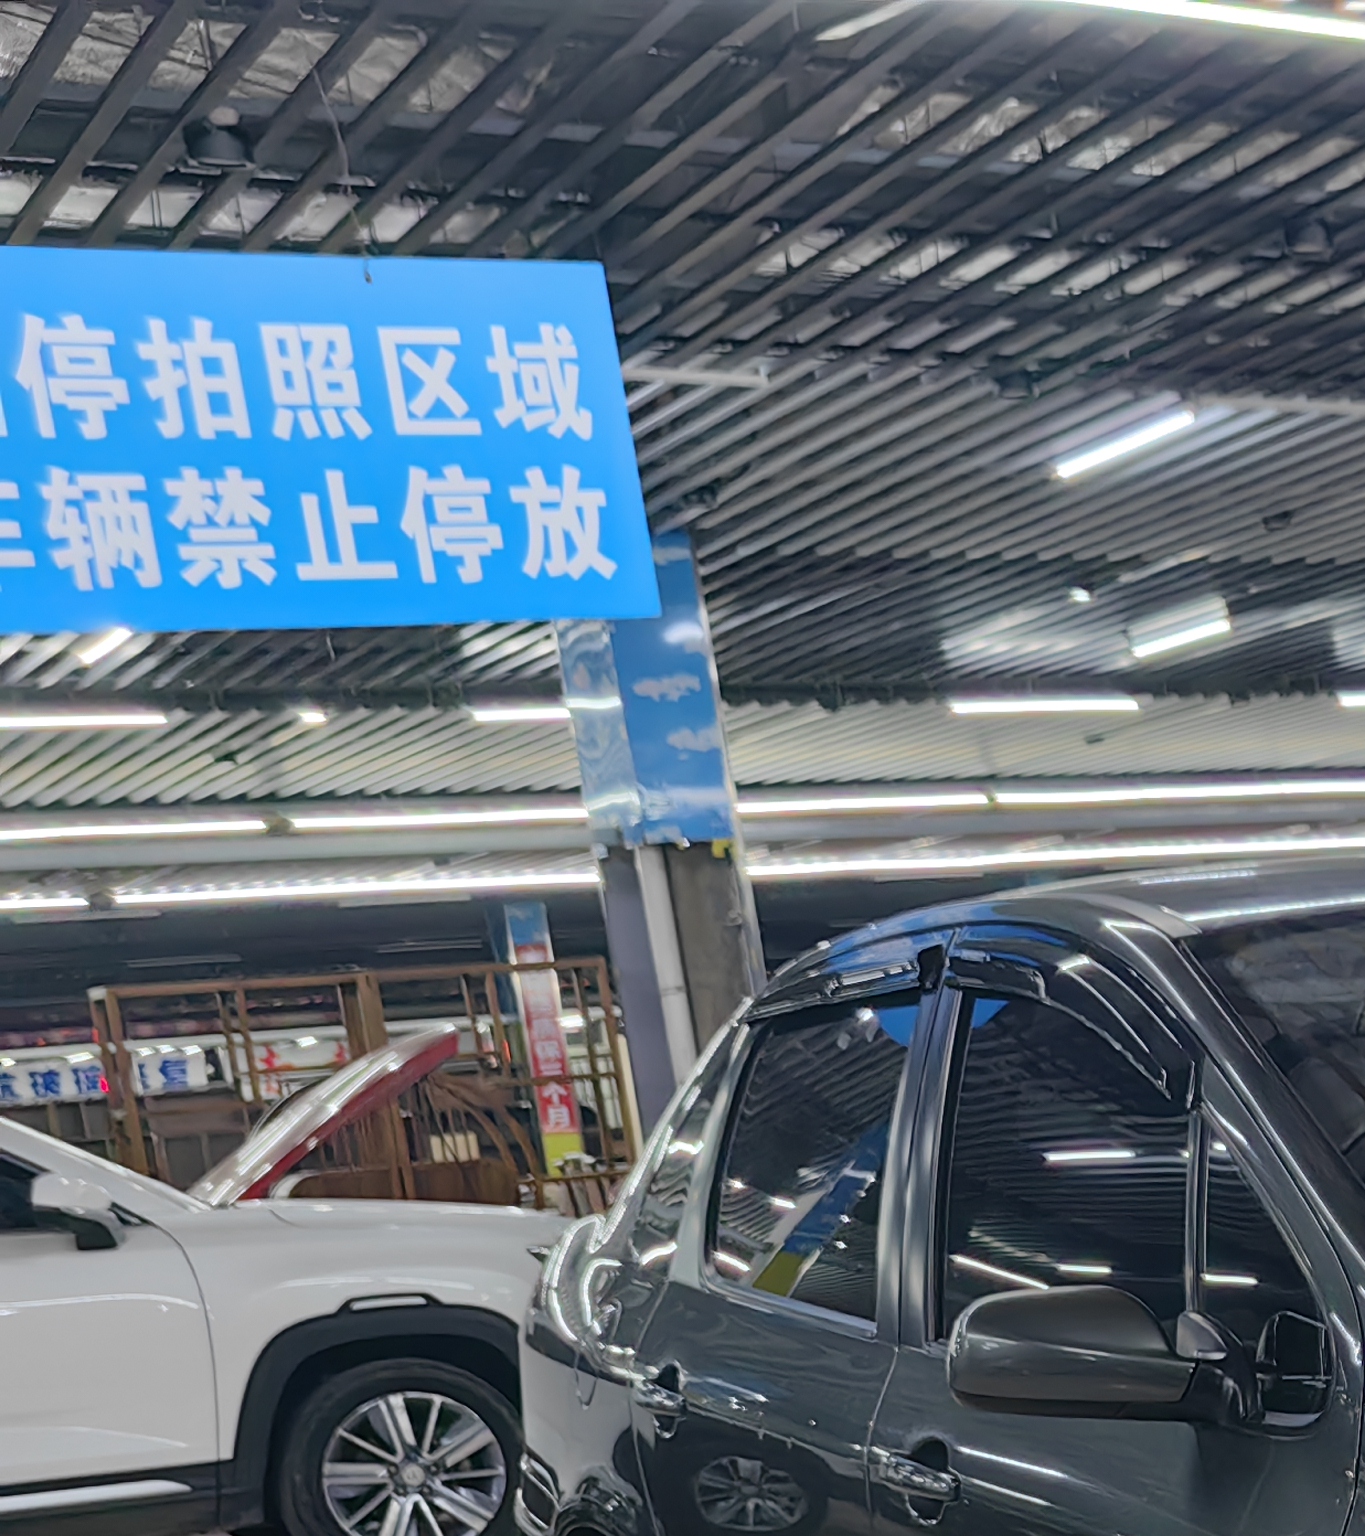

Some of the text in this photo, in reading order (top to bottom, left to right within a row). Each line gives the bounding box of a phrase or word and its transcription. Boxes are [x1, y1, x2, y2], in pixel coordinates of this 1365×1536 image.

[0, 313, 594, 442] 停拍照区域
